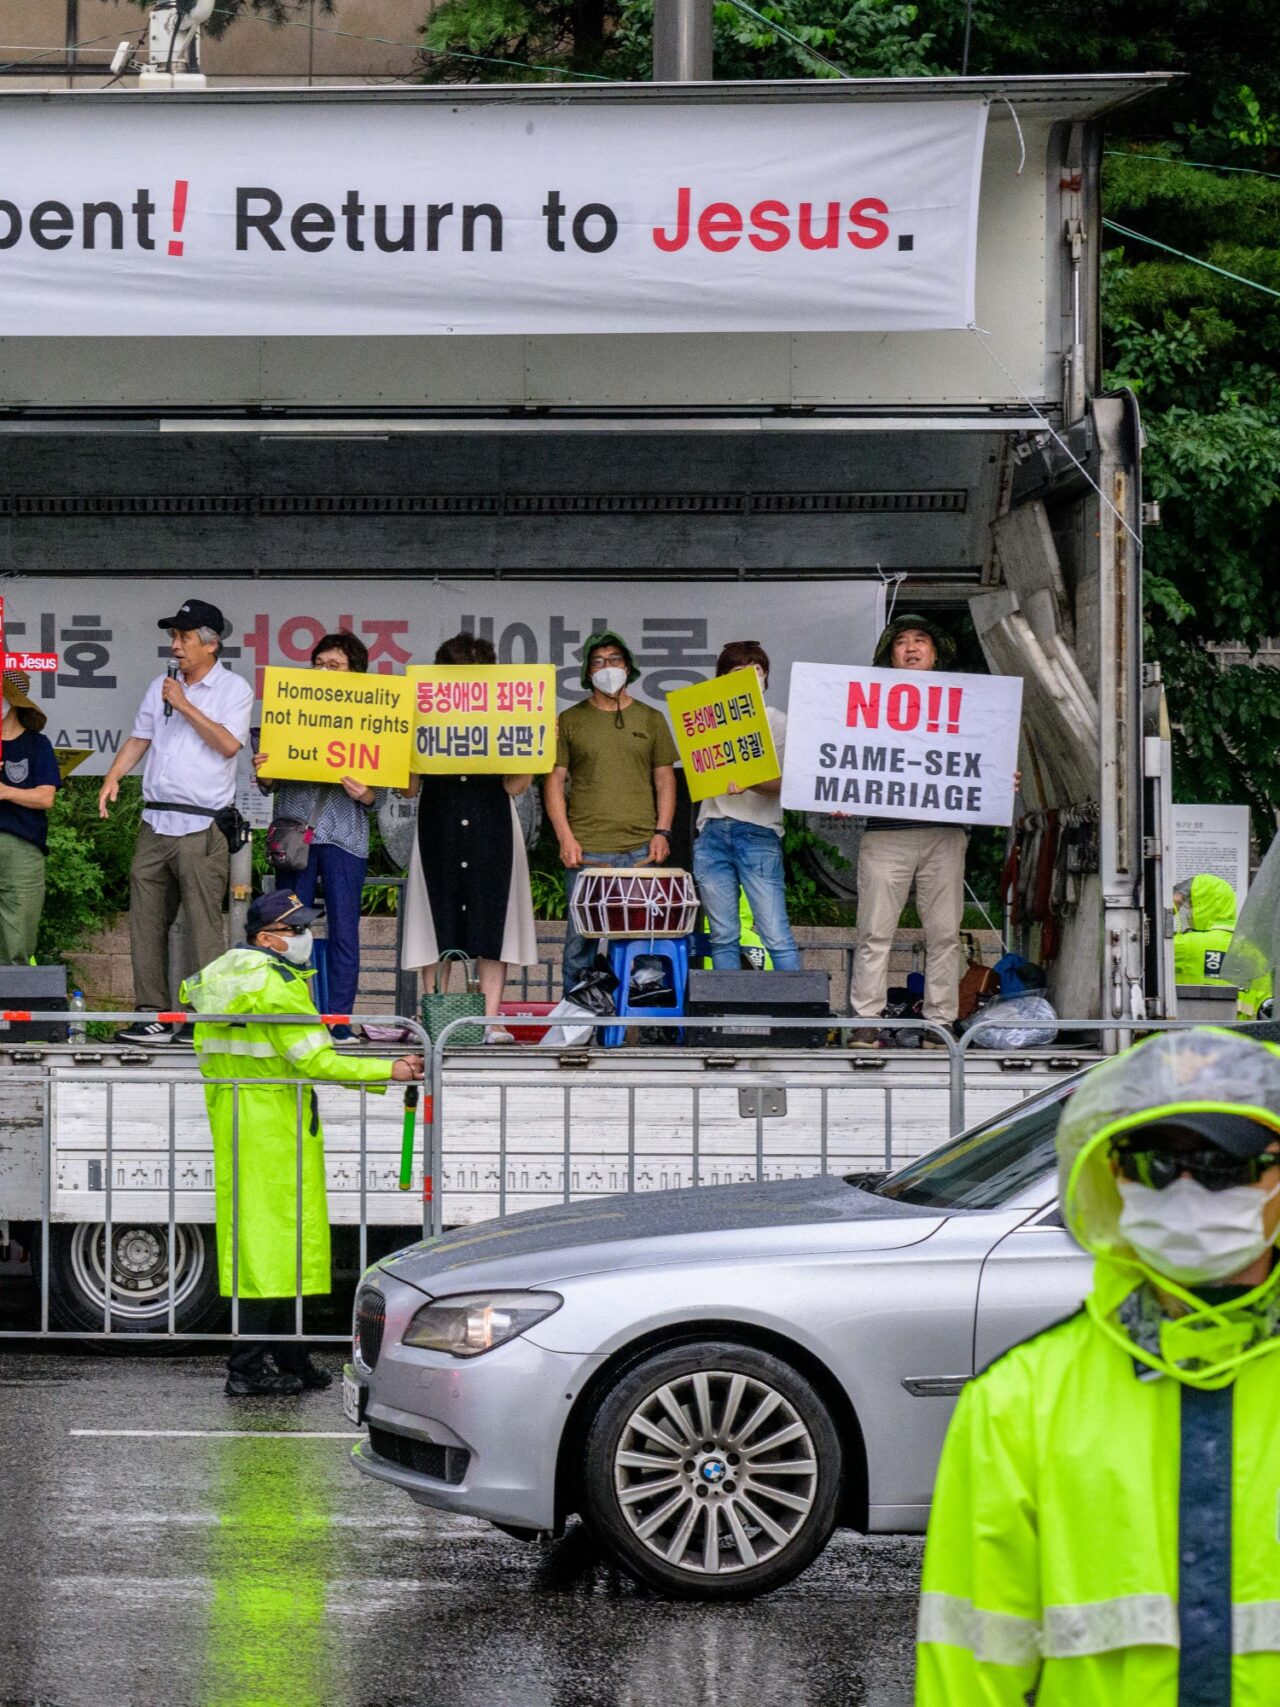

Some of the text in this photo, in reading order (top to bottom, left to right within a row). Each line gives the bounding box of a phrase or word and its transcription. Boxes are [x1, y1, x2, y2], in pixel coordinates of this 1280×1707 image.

[236, 187, 502, 252] Return
[542, 190, 617, 253] to
[652, 187, 914, 252] Jesus.
[5, 654, 17, 669] in
[19, 654, 57, 670] Jesus
[277, 681, 401, 709] Homosexuality
[416, 681, 545, 713] 동성애의 죄악!
[846, 681, 964, 734] NO!!
[264, 709, 409, 734] not human rights
[682, 692, 756, 737] 동성애의 비극!
[288, 740, 381, 770] but SIN
[416, 725, 546, 756] 하나님의 심판!
[691, 731, 765, 773] 에이즈의 창궐!
[818, 742, 982, 778] SAME-SEX
[814, 776, 982, 812] MARRIAGE
[1205, 950, 1222, 970] 경
